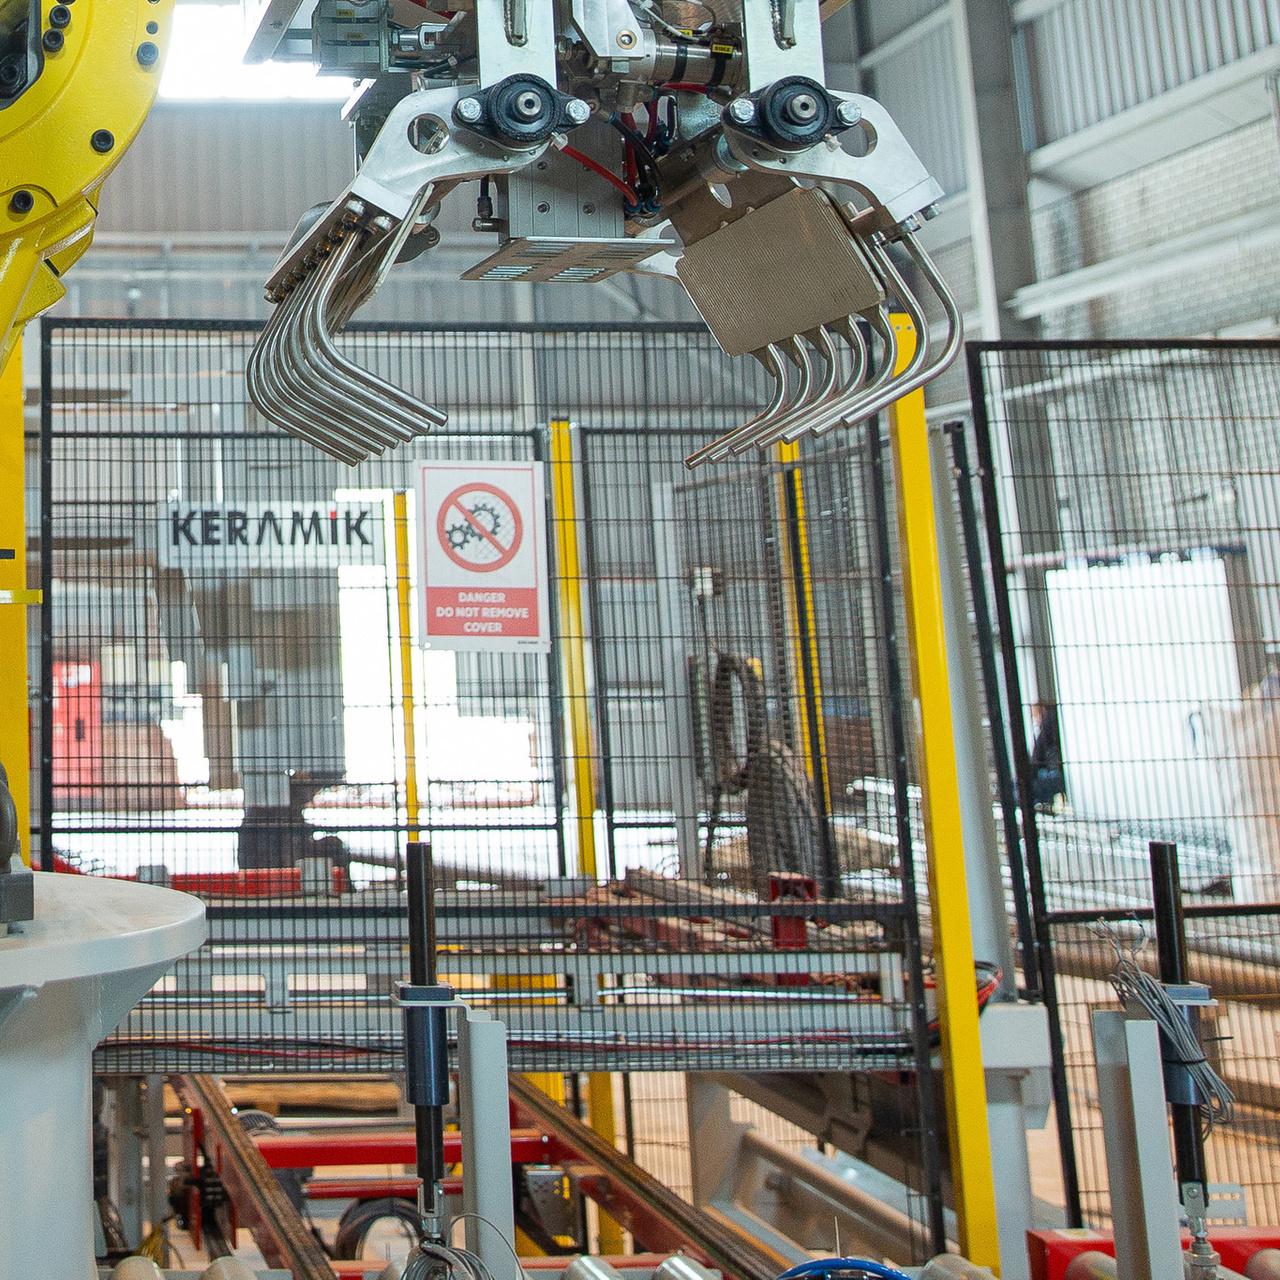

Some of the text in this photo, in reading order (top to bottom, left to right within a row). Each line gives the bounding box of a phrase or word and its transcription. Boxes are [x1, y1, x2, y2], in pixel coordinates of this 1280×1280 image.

[458, 592, 506, 603] DANGER
[436, 606, 530, 619] DO NOT REMOVE
[463, 622, 503, 632] COVER
